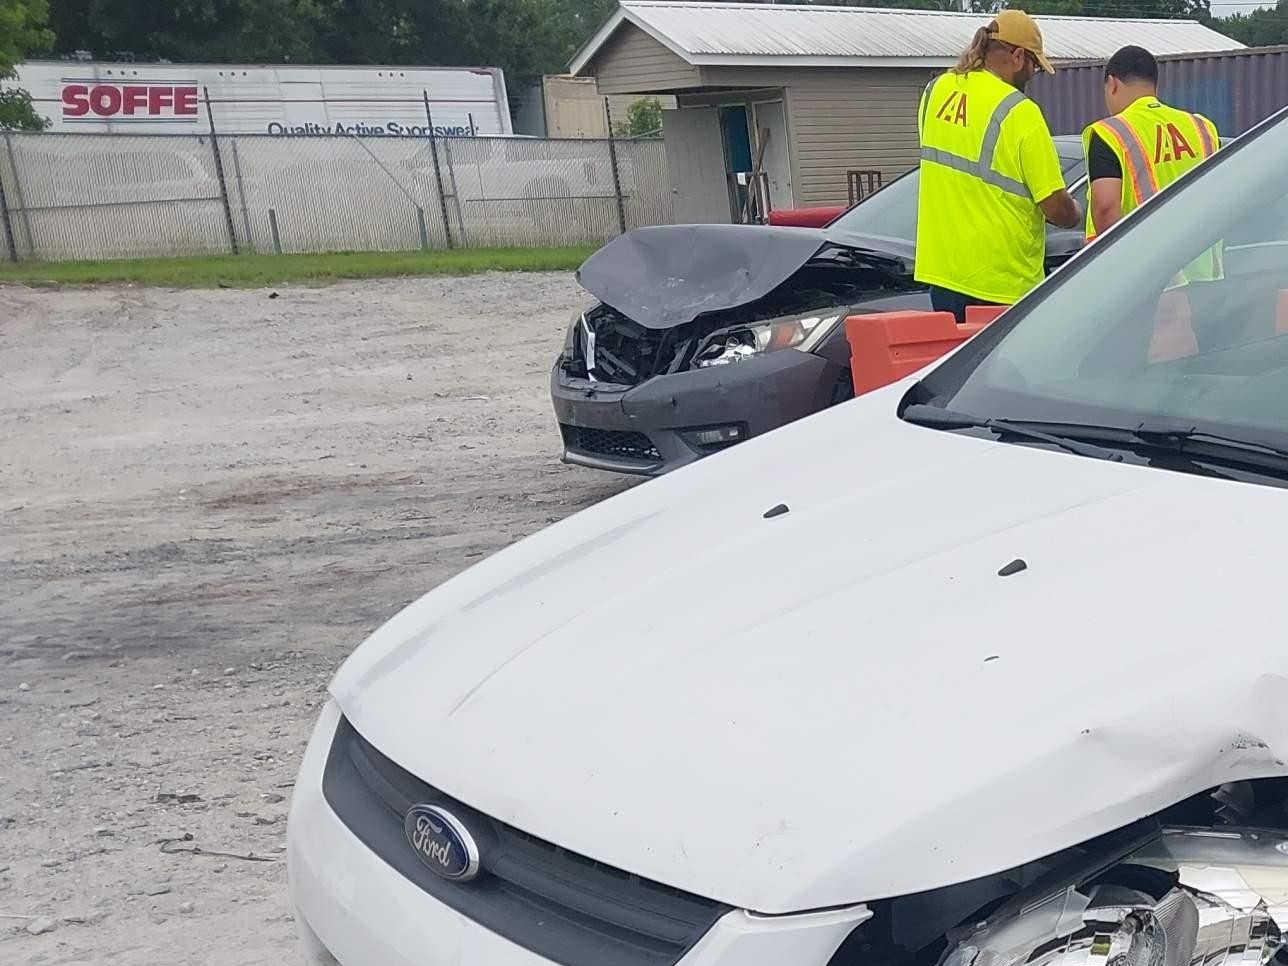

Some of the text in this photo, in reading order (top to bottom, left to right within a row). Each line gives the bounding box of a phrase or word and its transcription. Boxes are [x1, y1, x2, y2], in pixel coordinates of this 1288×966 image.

[62, 85, 198, 116] SOFFE
[335, 122, 384, 136] Active
[413, 815, 451, 866] Ford
